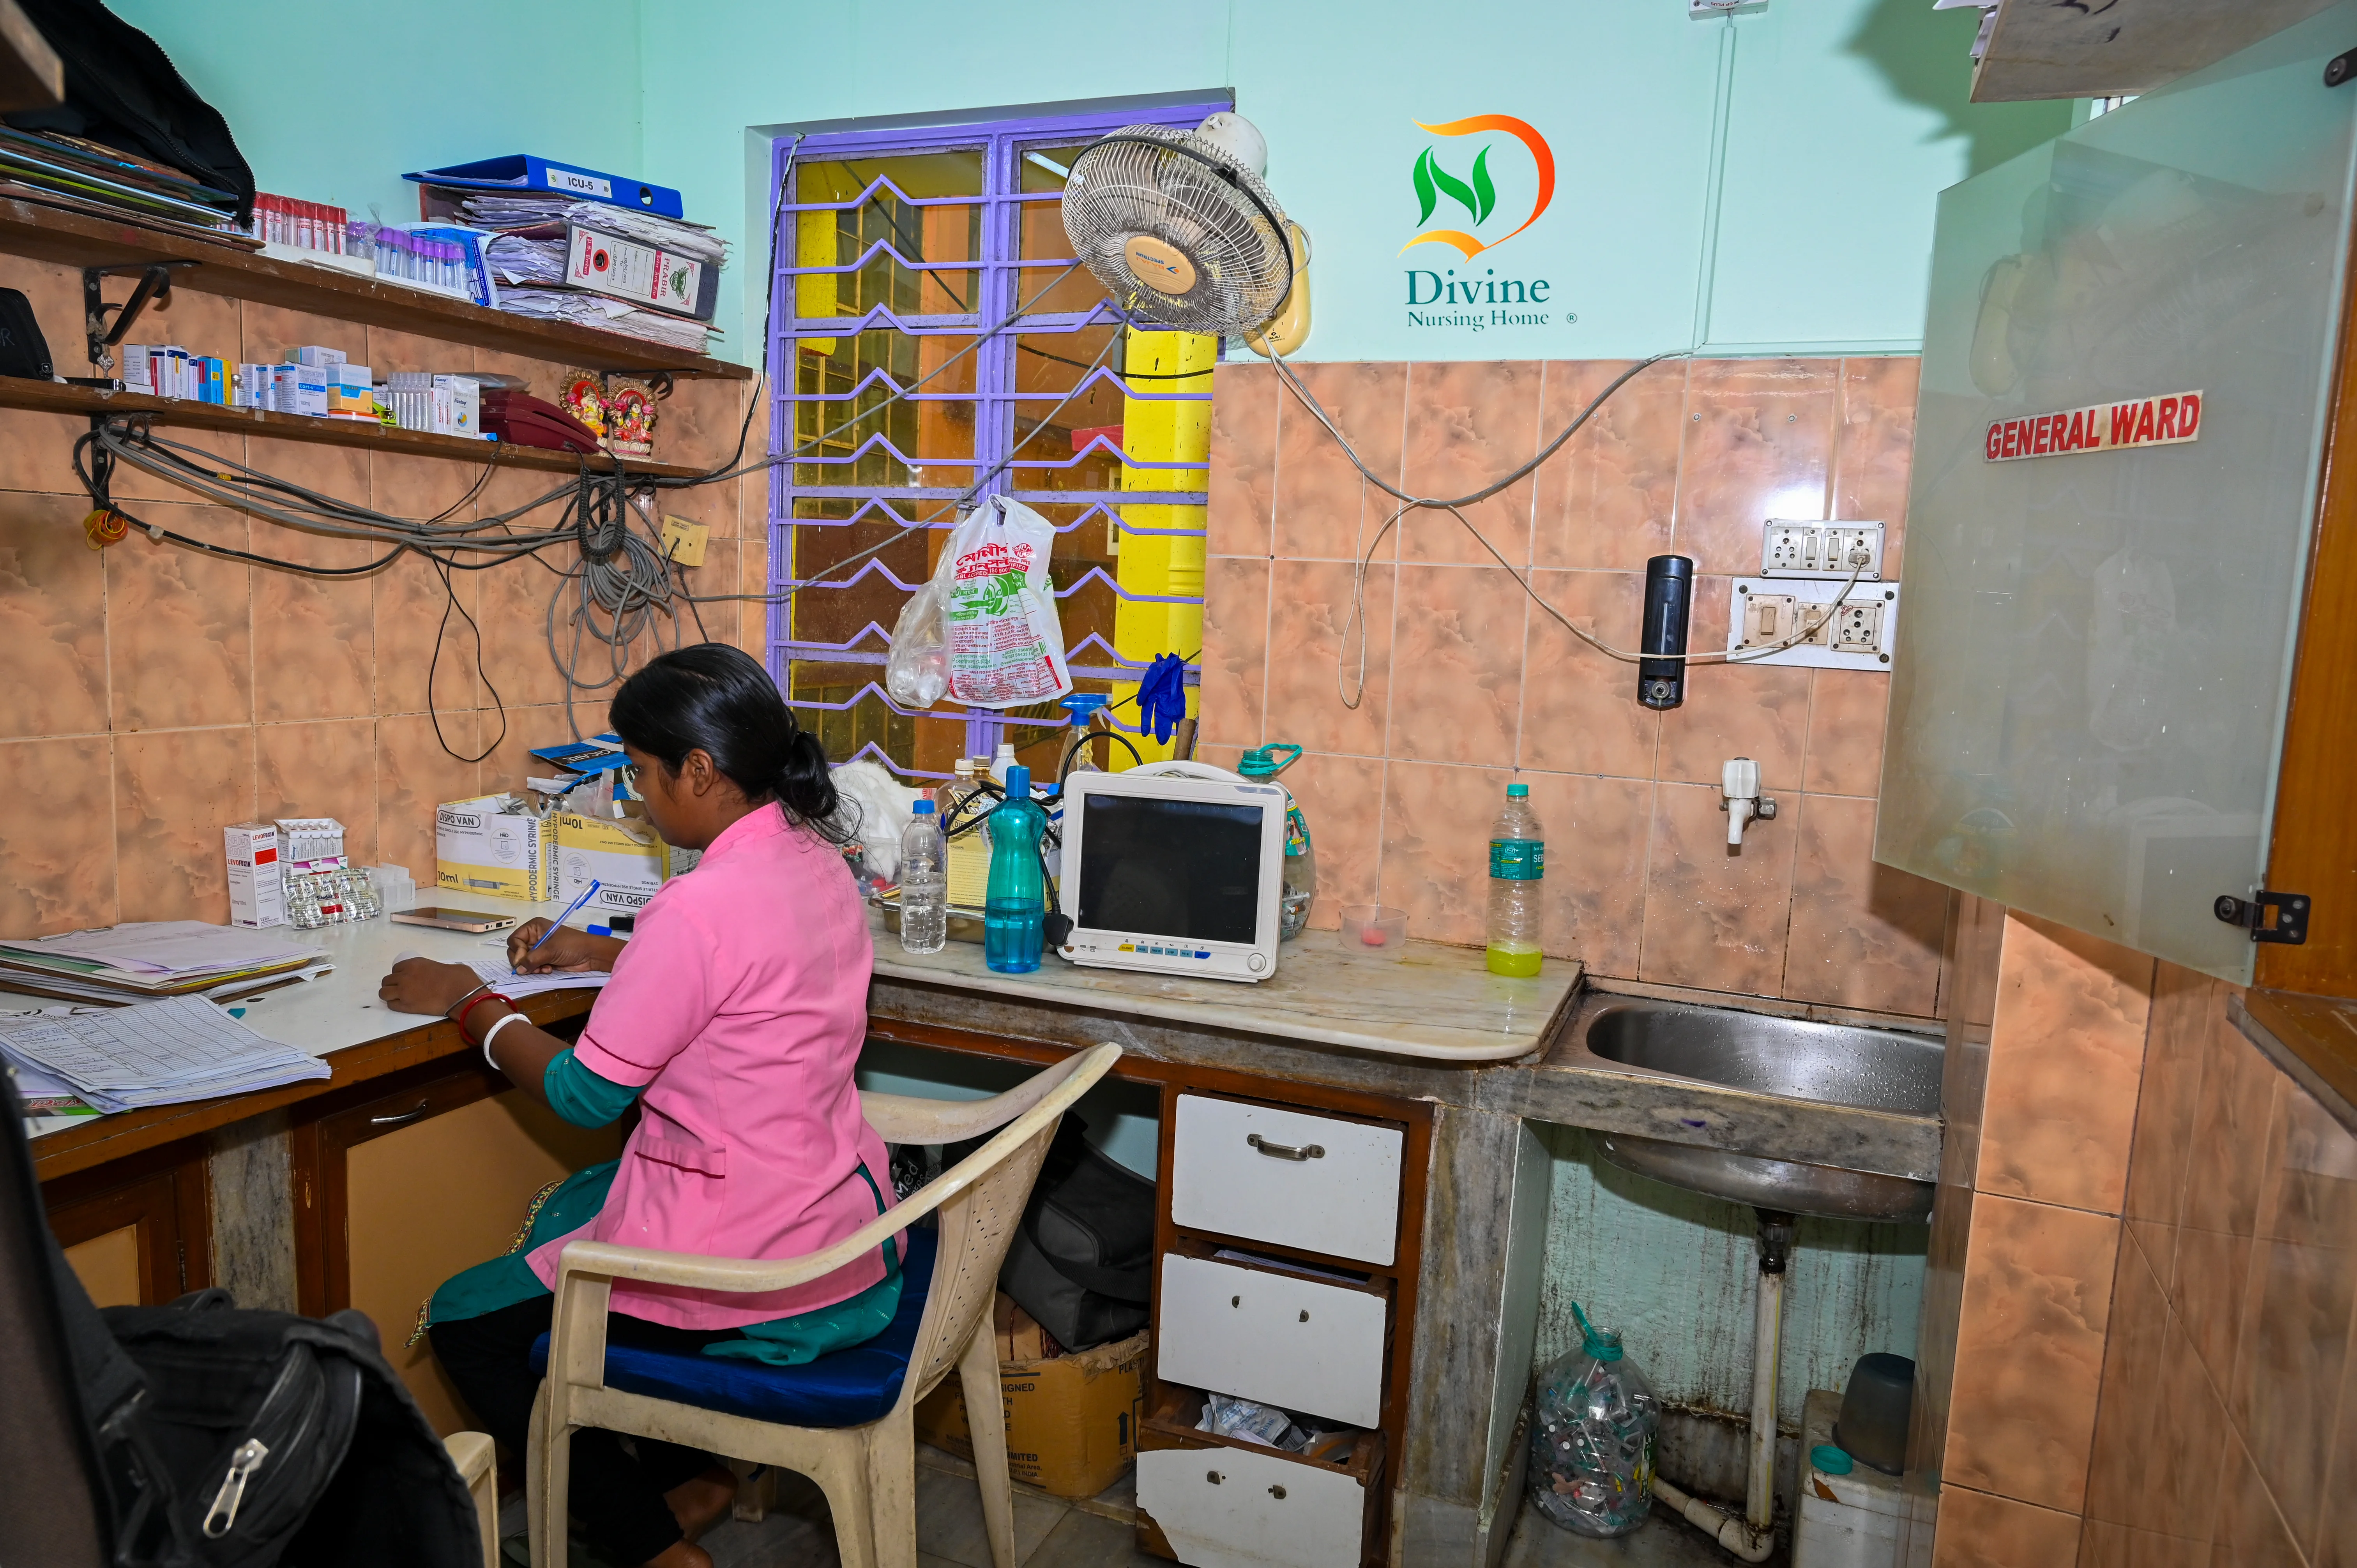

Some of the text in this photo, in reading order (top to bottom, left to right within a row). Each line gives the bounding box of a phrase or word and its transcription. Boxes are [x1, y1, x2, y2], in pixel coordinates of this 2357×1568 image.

[568, 177, 594, 190] ICU-5
[1136, 251, 1164, 265] SPECTRUM
[660, 258, 670, 297] PRABIR
[1404, 268, 1550, 305] Divine
[1408, 310, 1484, 332] Nursing
[1491, 310, 1549, 325] Home
[1986, 395, 2200, 459] GENERAL WARD
[562, 750, 611, 763] GICARE
[439, 812, 474, 826] DISPO VAN
[560, 816, 583, 830] 10ml
[955, 821, 974, 831] DISO
[226, 836, 251, 846] LEVOFLOXACIN
[252, 831, 275, 841] LEVOFUXIN
[228, 859, 251, 867] LEVOFUXIN
[438, 871, 459, 883] 10ml
[528, 849, 537, 902] HYPODERMIC
[288, 883, 345, 896] Silodosin Capsules
[606, 892, 624, 903] VAN
[1007, 1452, 1038, 1462] IMITED
